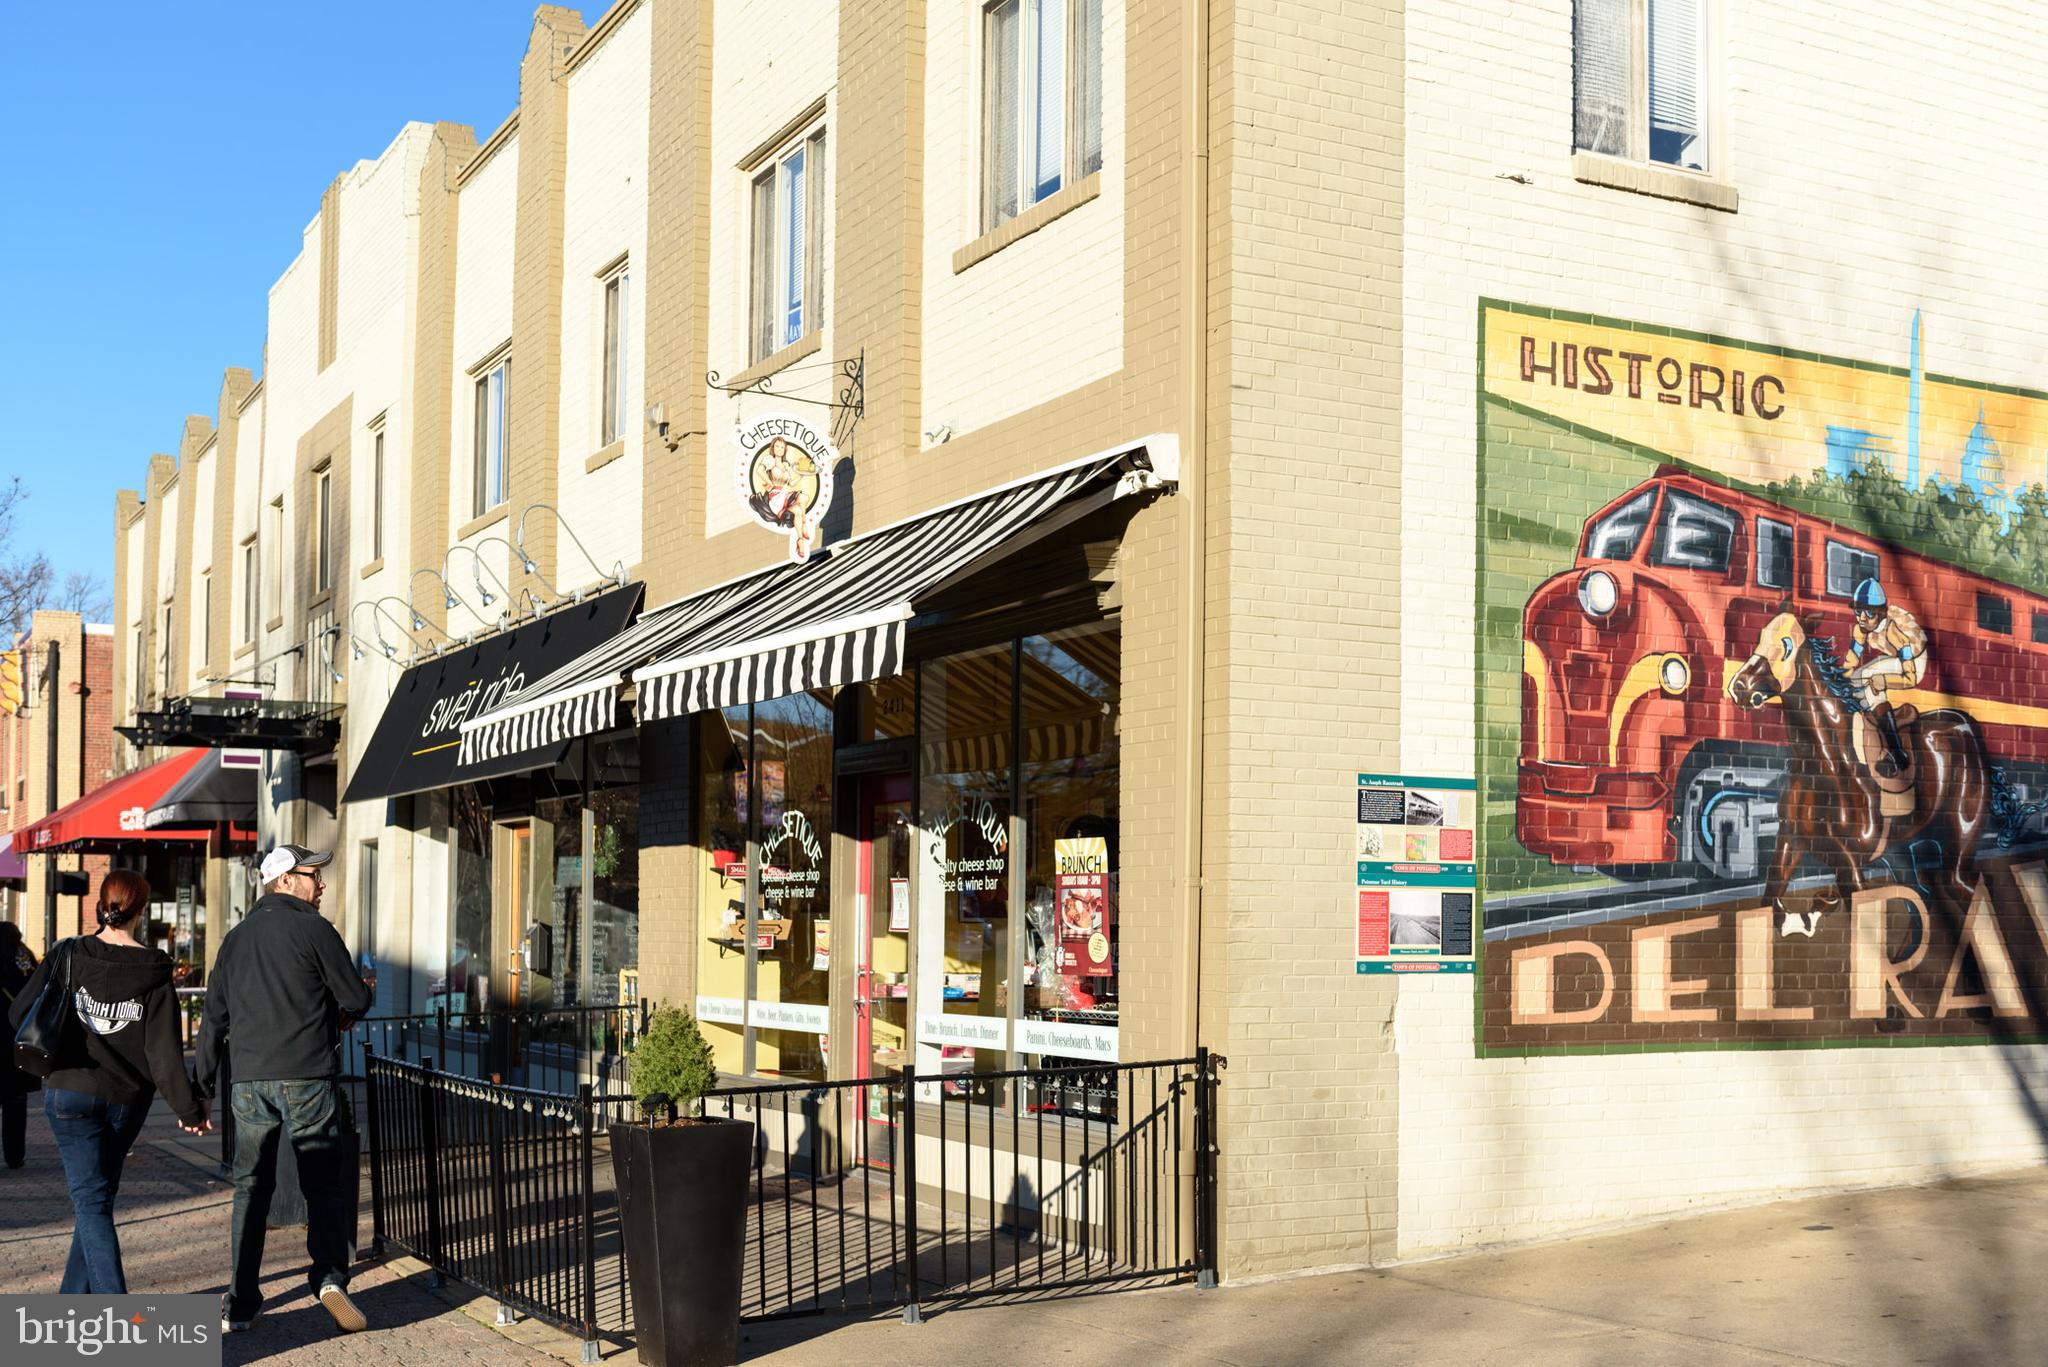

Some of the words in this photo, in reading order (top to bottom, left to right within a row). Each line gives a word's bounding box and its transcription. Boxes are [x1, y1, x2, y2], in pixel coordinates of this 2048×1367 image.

[1520, 336, 1785, 420] HISTORIC
[740, 418, 830, 460] CHEESETIQUE
[759, 809, 823, 869] CHEESETIQUE
[958, 857, 985, 872] cheese
[985, 856, 1004, 874] shop
[1061, 855, 1102, 874] BRUNCH
[786, 868, 805, 882] cheese
[806, 867, 820, 884] shop
[957, 877, 964, 892] &
[965, 876, 983, 891] wine
[984, 875, 999, 890] bar
[765, 885, 784, 898] cheese
[790, 886, 804, 898] wine
[805, 885, 816, 898] bar
[1511, 906, 1814, 1025] DEL
[979, 1025, 999, 1040] Dinner
[1048, 1031, 1093, 1050] Cheeseboards,
[1095, 1035, 1112, 1052] Macs
